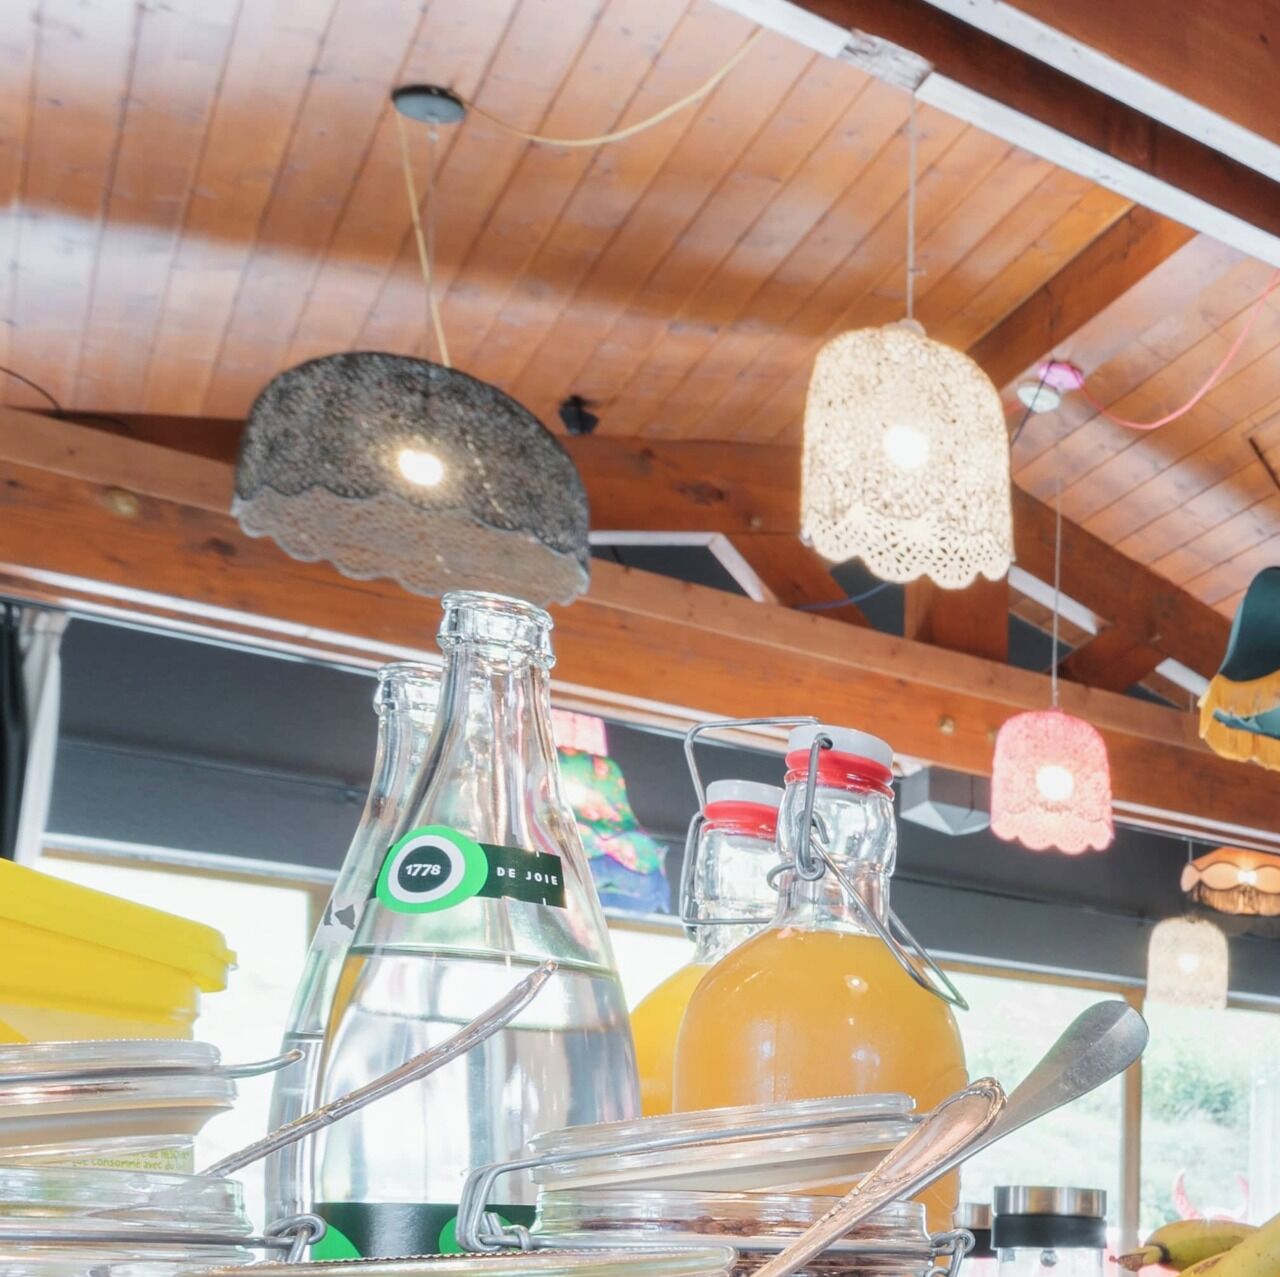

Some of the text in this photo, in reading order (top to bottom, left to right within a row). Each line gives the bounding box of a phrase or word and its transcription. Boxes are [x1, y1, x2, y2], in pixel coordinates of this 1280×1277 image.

[405, 863, 442, 877] 1778
[496, 866, 559, 886] DE JOIE
